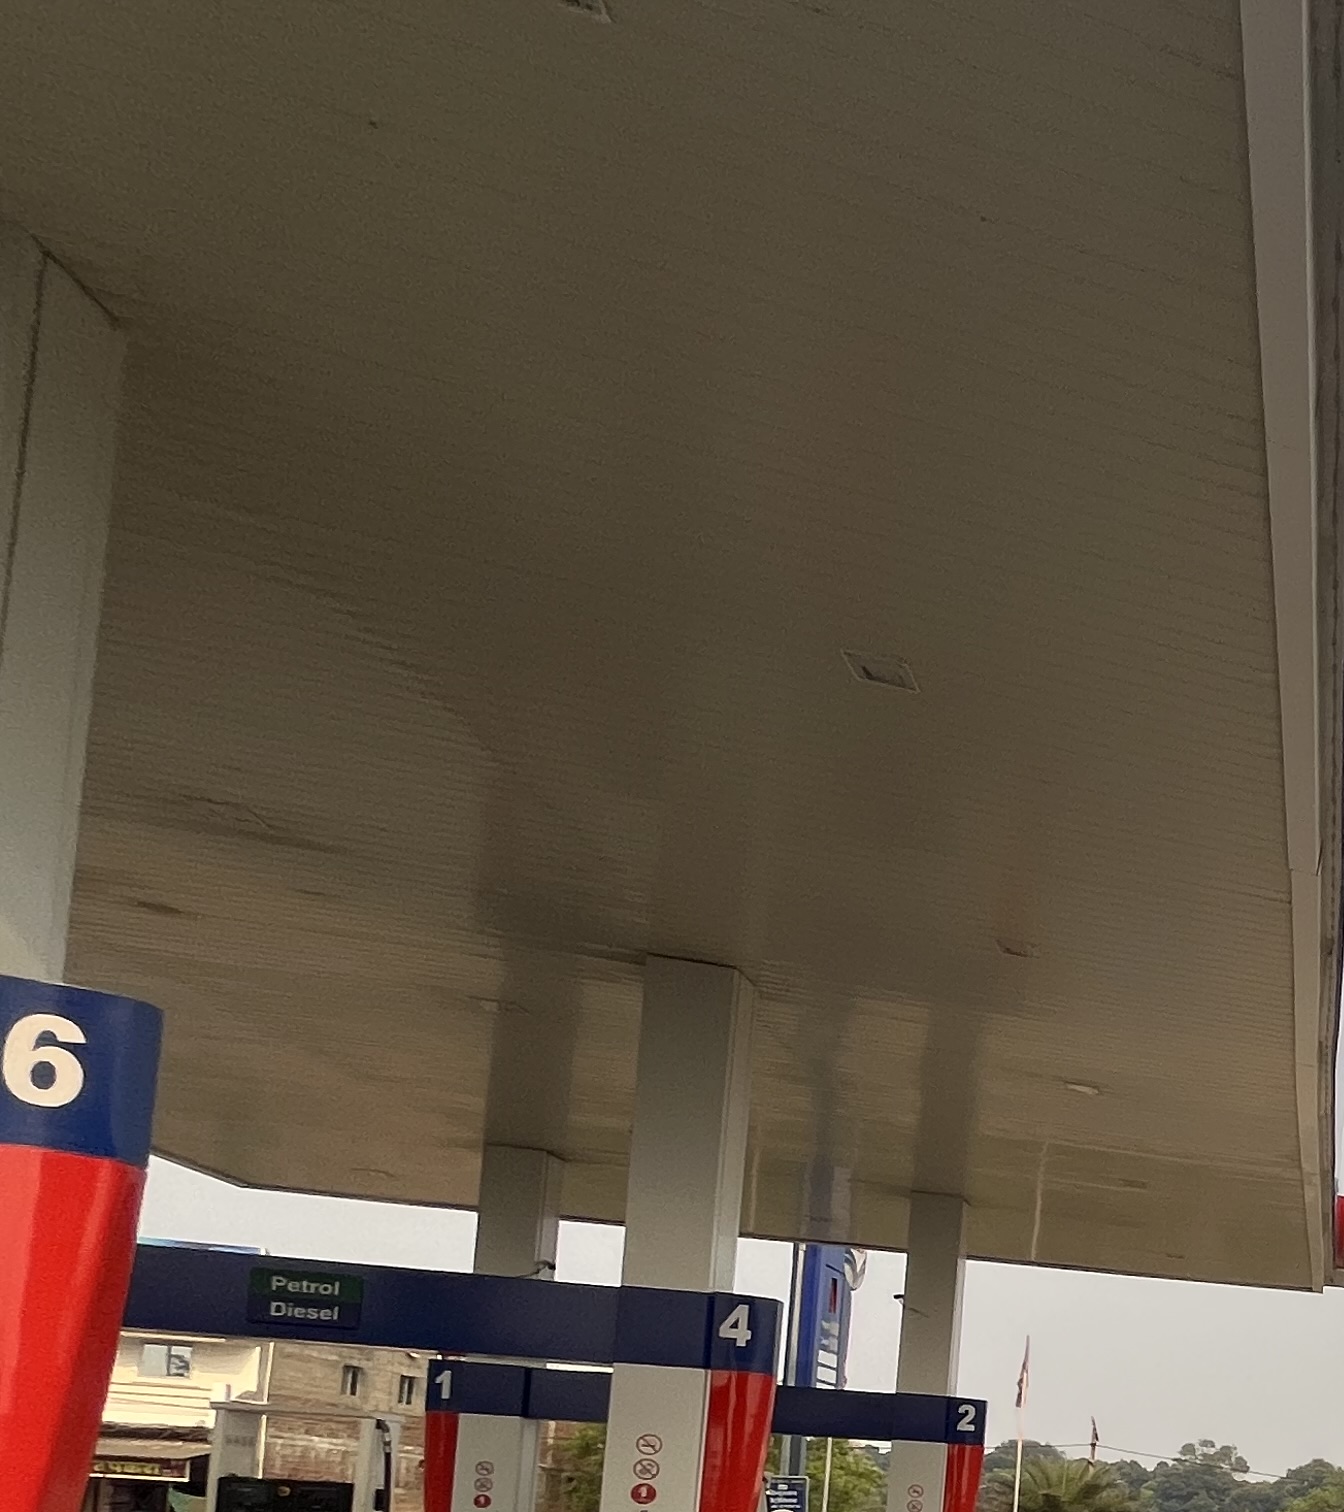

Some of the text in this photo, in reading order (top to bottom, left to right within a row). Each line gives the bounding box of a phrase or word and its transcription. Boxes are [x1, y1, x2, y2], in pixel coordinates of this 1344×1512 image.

[2, 1013, 87, 1108] 6
[271, 1276, 340, 1296] Petrol
[270, 1301, 339, 1321] Diesel
[719, 1304, 752, 1347] 4
[435, 1370, 452, 1400] 1
[957, 1404, 976, 1432] 2
